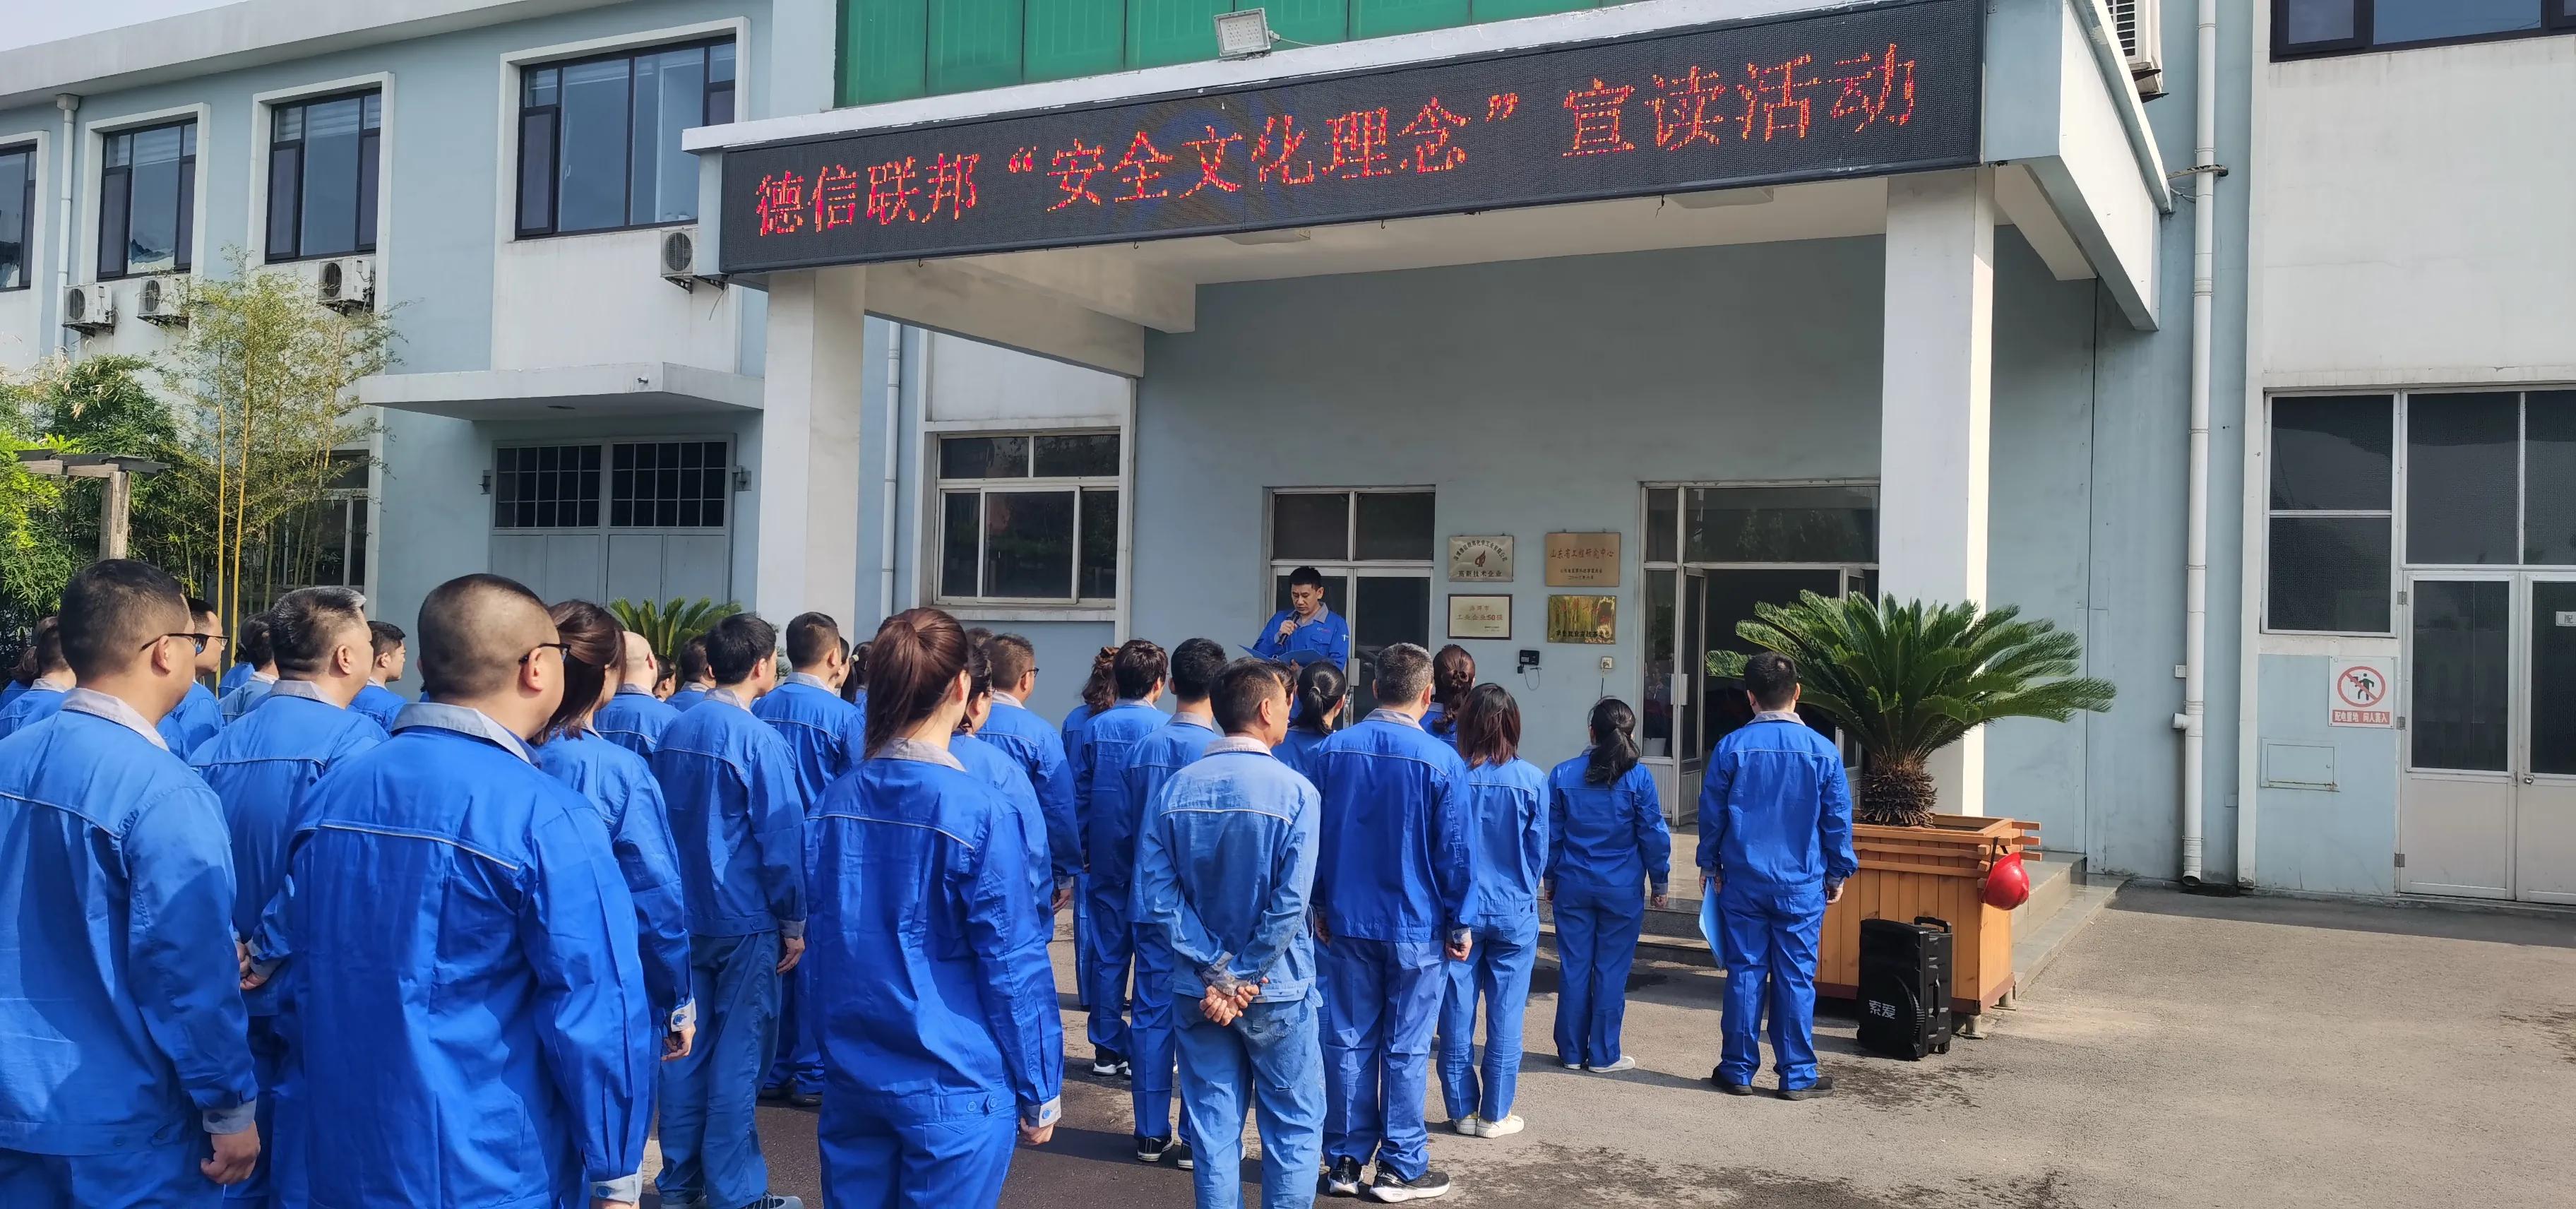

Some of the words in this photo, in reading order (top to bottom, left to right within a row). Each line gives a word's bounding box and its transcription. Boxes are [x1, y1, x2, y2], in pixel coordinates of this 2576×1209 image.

[1458, 567, 1502, 577] 高新技术企业
[2334, 711, 2359, 723] 配电重地
[1868, 1000, 1895, 1019] 索爱
